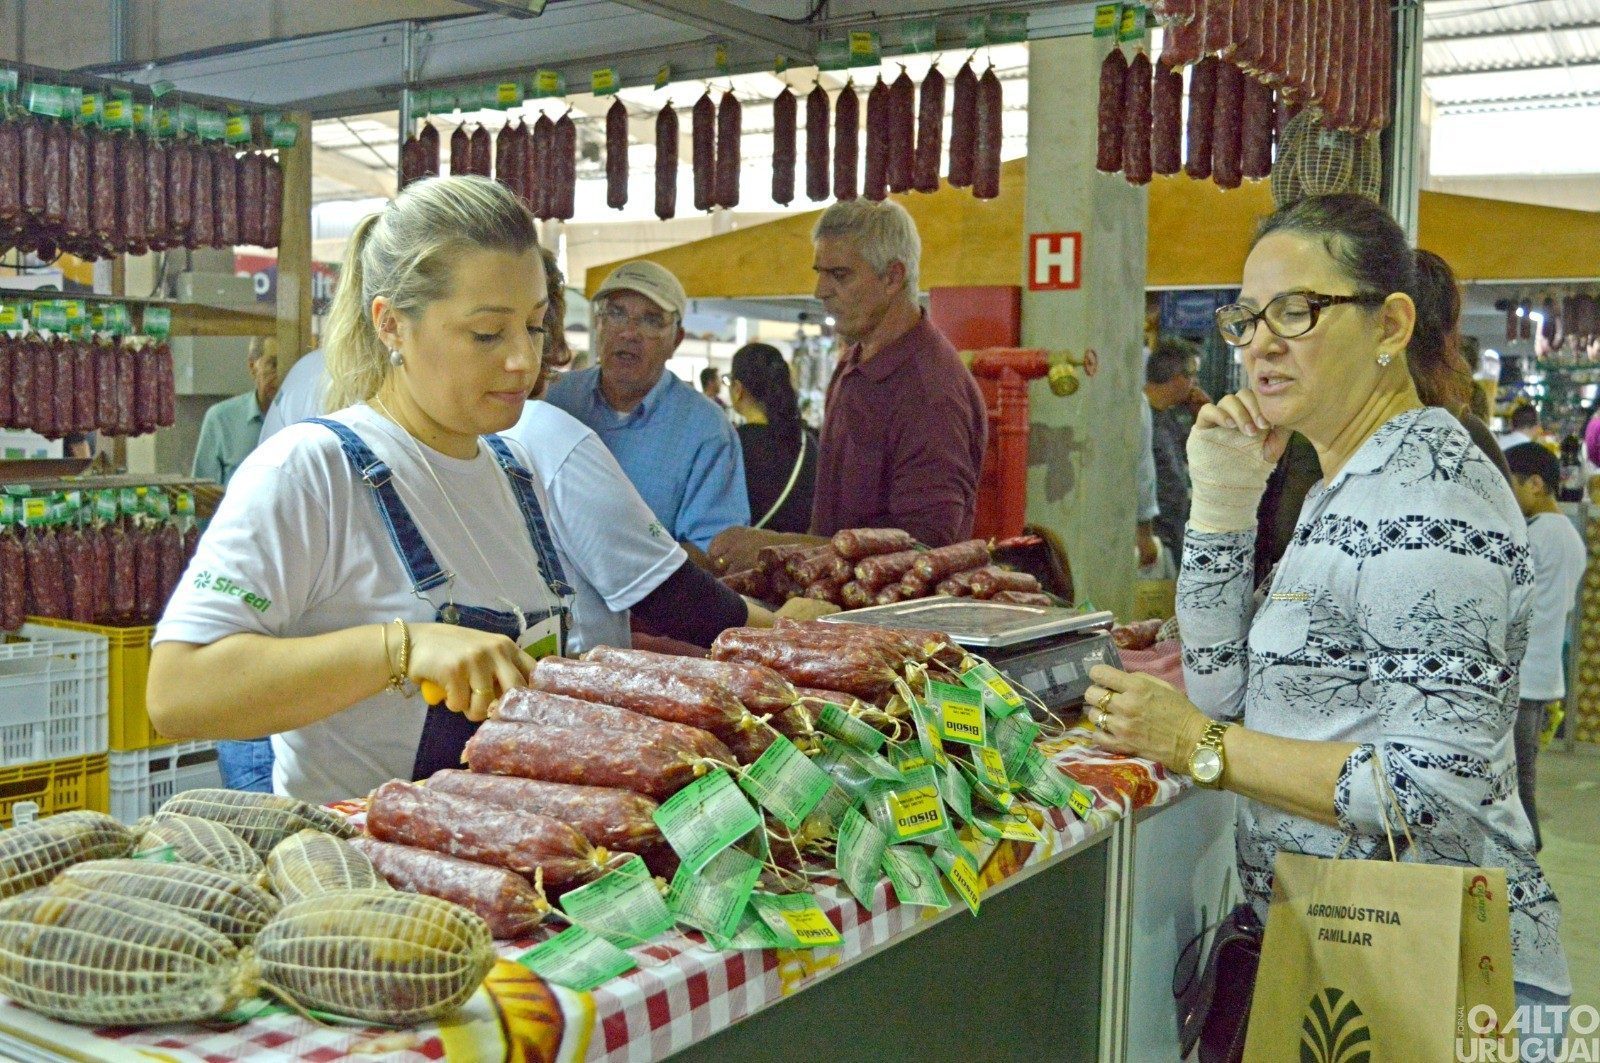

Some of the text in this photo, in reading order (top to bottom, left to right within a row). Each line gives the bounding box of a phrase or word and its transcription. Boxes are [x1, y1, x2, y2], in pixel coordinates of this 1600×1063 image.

[1035, 237, 1075, 284] H
[212, 576, 272, 613] Sicredi
[946, 721, 980, 736] Bisolo
[898, 809, 939, 828] Bisolo
[953, 869, 978, 904] Bisolo
[1306, 904, 1402, 926] AGROINDÚSTRIA
[1318, 927, 1373, 947] FAMILIAR
